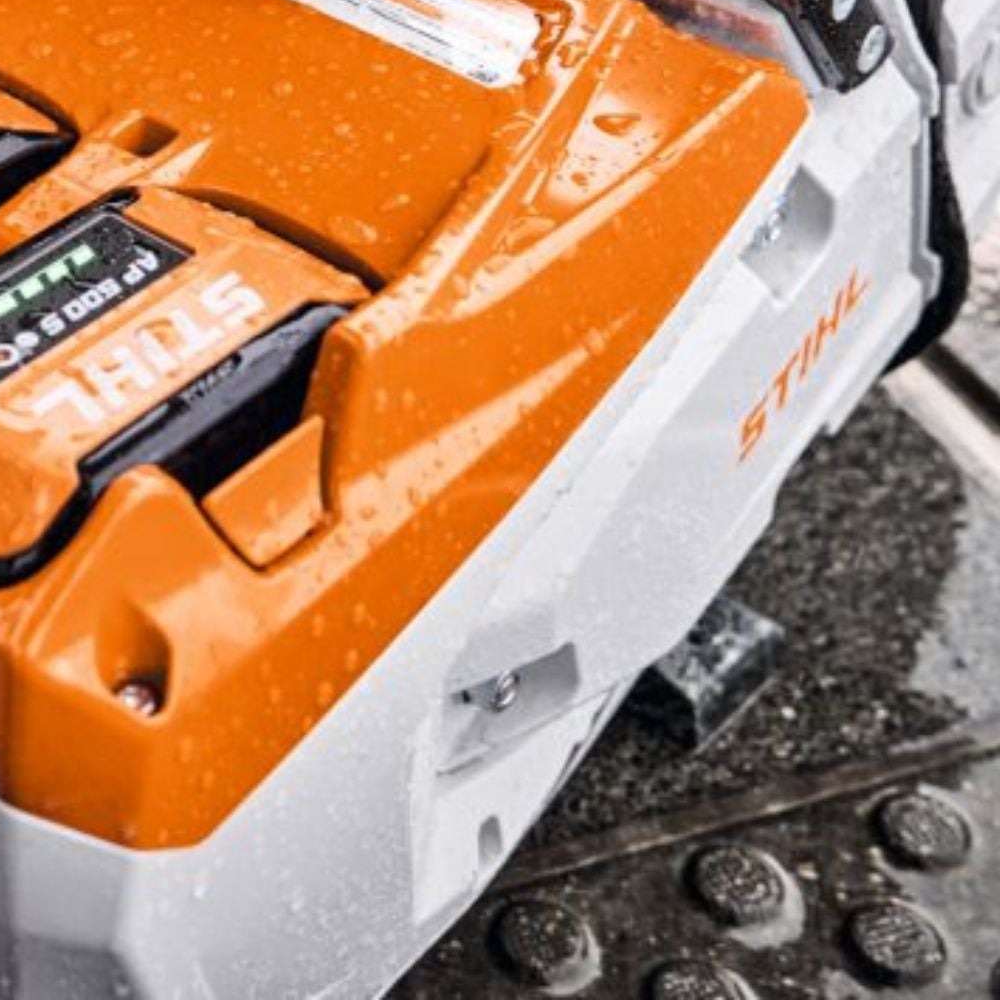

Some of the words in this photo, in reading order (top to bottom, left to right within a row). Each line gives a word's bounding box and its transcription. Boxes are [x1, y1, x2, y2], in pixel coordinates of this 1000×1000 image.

[63, 277, 122, 323] 500
[122, 245, 160, 286] AP
[30, 270, 266, 425] STIHL
[738, 264, 869, 463] STIHL
